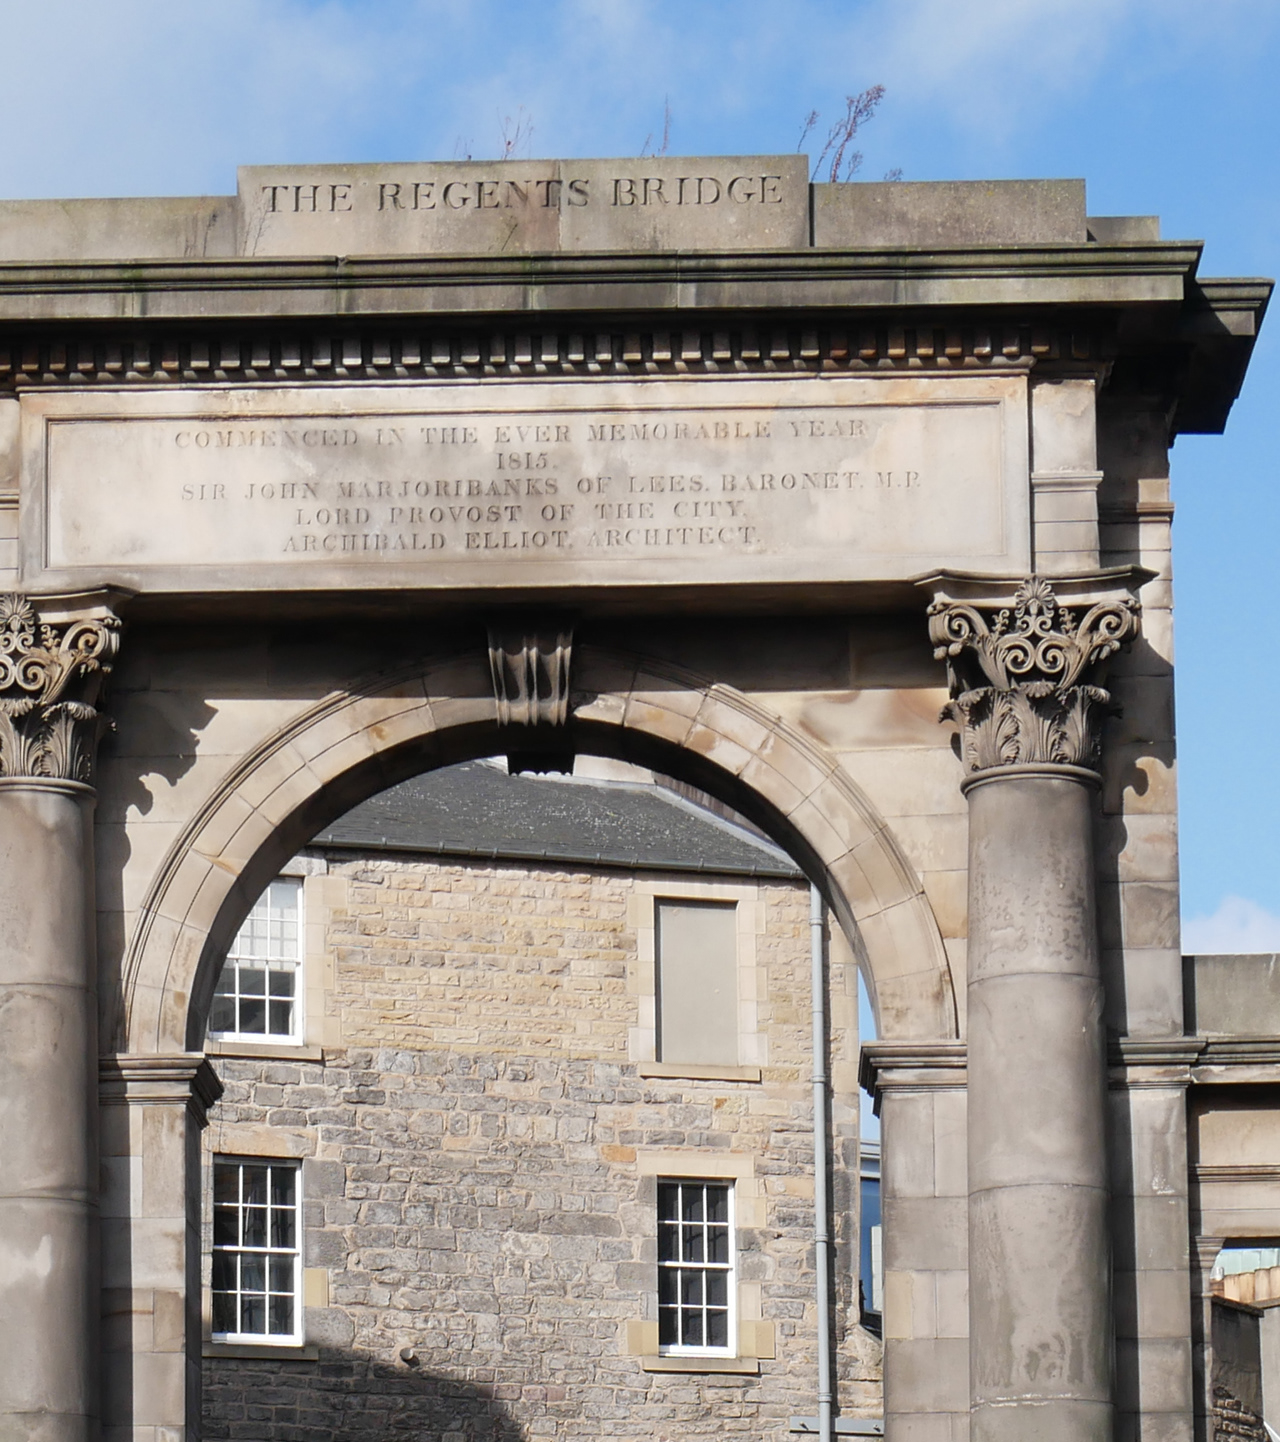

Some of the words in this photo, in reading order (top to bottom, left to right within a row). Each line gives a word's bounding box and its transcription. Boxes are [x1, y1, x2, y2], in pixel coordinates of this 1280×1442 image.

[262, 183, 353, 213] THE
[377, 178, 589, 212] REGENTS
[610, 174, 783, 206] BRIDGE
[175, 427, 359, 449] COMMENCED
[376, 427, 406, 446] IN
[420, 426, 478, 445] THE
[494, 424, 571, 444] EVER
[587, 420, 771, 442] MEMORABLE
[788, 418, 868, 439] YEAR
[181, 482, 227, 501] SIR
[244, 482, 320, 500] JOHN
[336, 478, 559, 499] MARJORIBANKS
[577, 476, 612, 494] OF
[296, 507, 370, 526] LORD
[389, 504, 522, 524] PROVOST
[541, 503, 575, 522] OF
[594, 502, 654, 520] THE
[283, 532, 446, 552] ARCHIBALD
